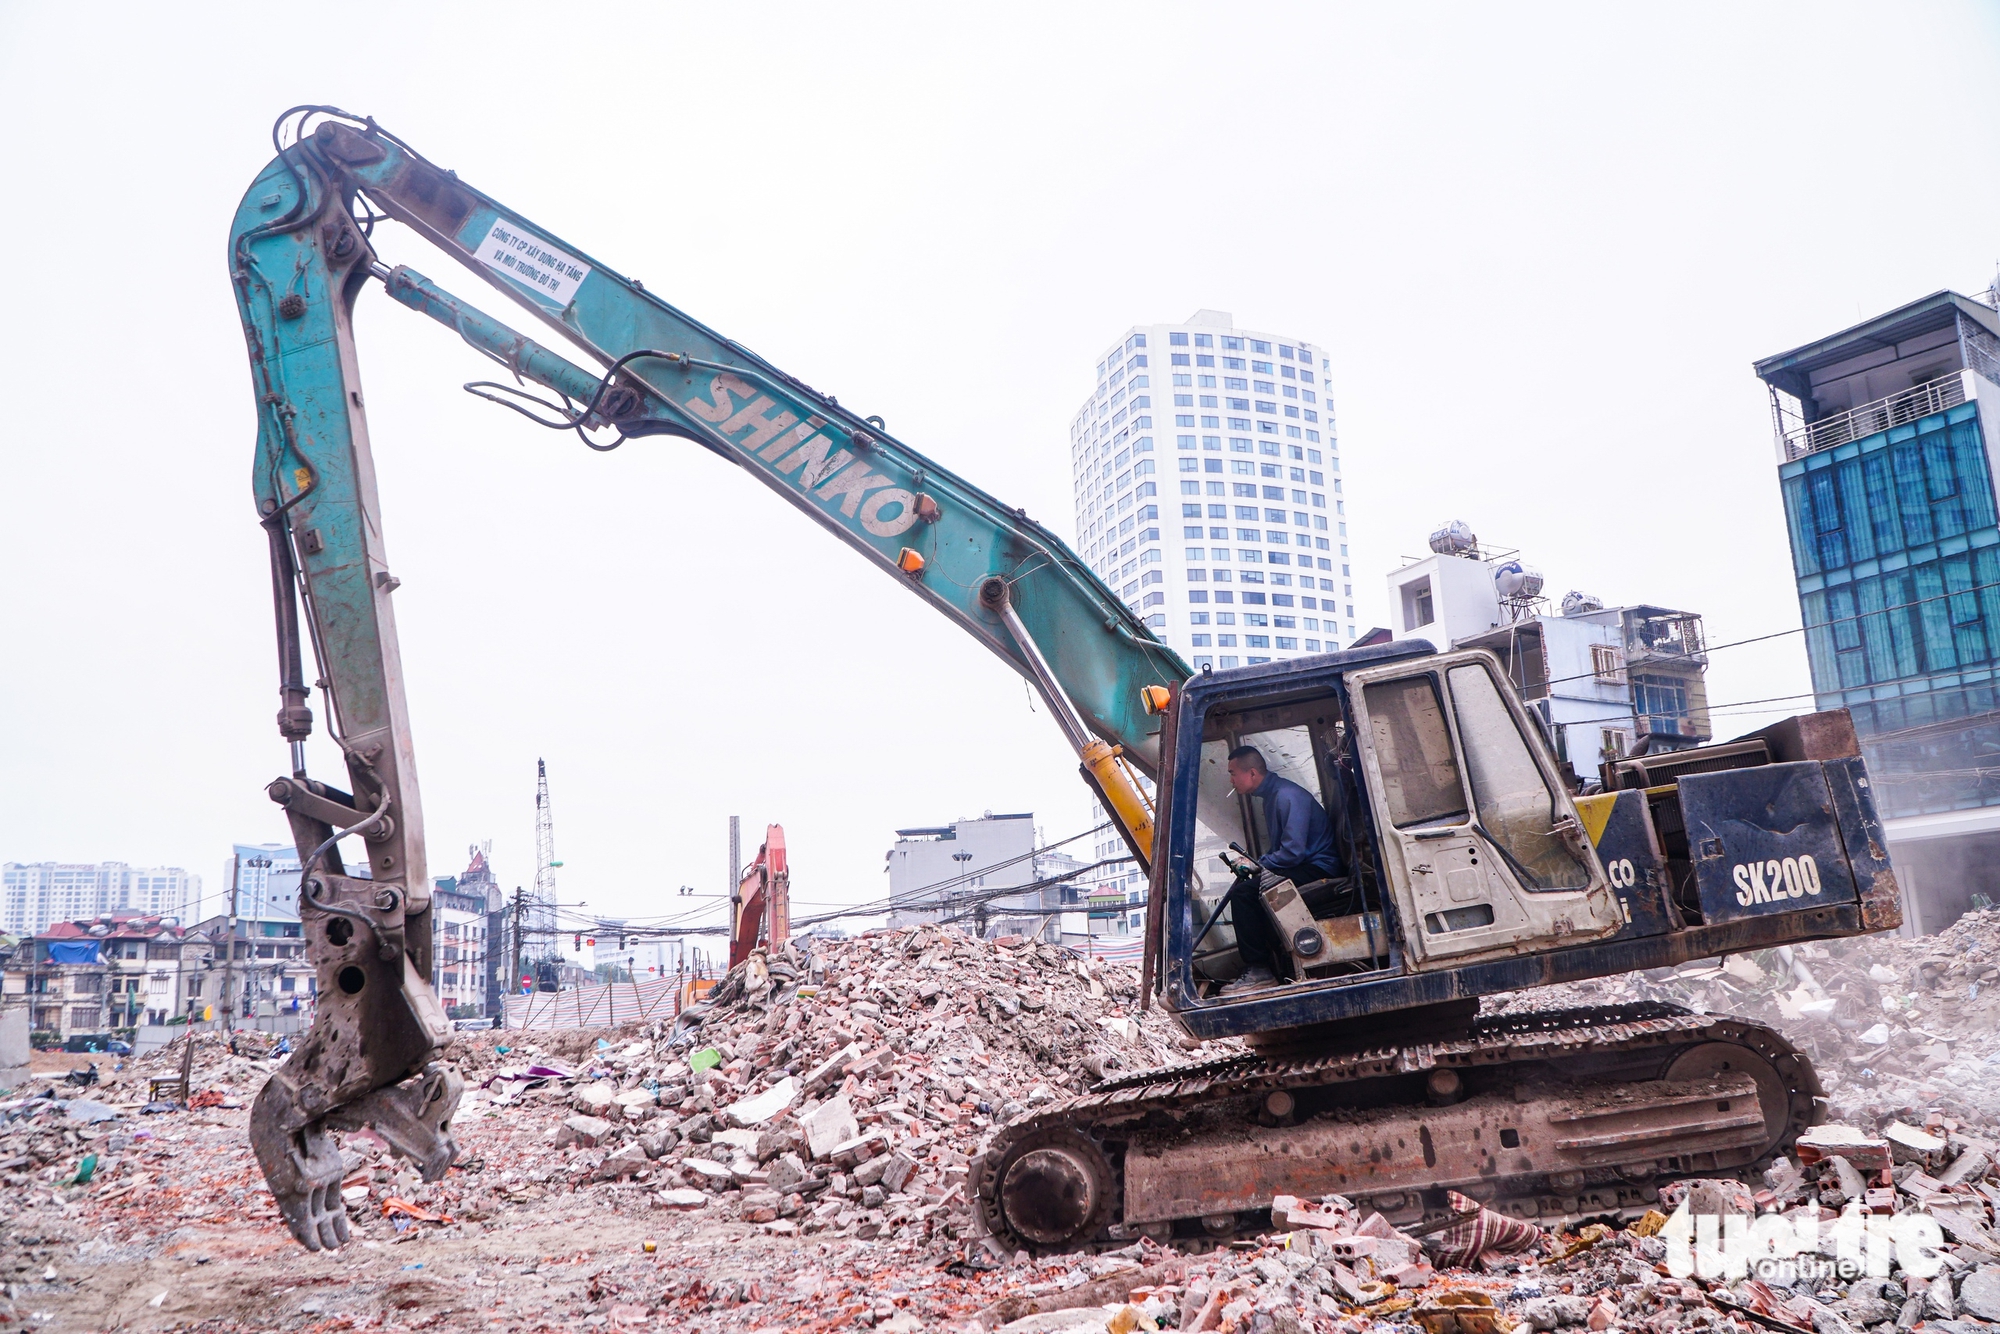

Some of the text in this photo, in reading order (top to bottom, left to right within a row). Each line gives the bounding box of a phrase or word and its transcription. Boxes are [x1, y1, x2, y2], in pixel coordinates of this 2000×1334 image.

[491, 227, 511, 244] CÔNG
[508, 235, 524, 248] TY
[516, 240, 528, 251] CP
[525, 244, 541, 259] XÂY
[554, 260, 567, 275] HẠ
[501, 254, 518, 269] MÔI
[537, 272, 551, 286] ĐÔ
[547, 277, 561, 294] THỊ
[684, 373, 920, 538] SHINKO
[1608, 858, 1635, 889] CO
[1732, 854, 1822, 907] SK200
